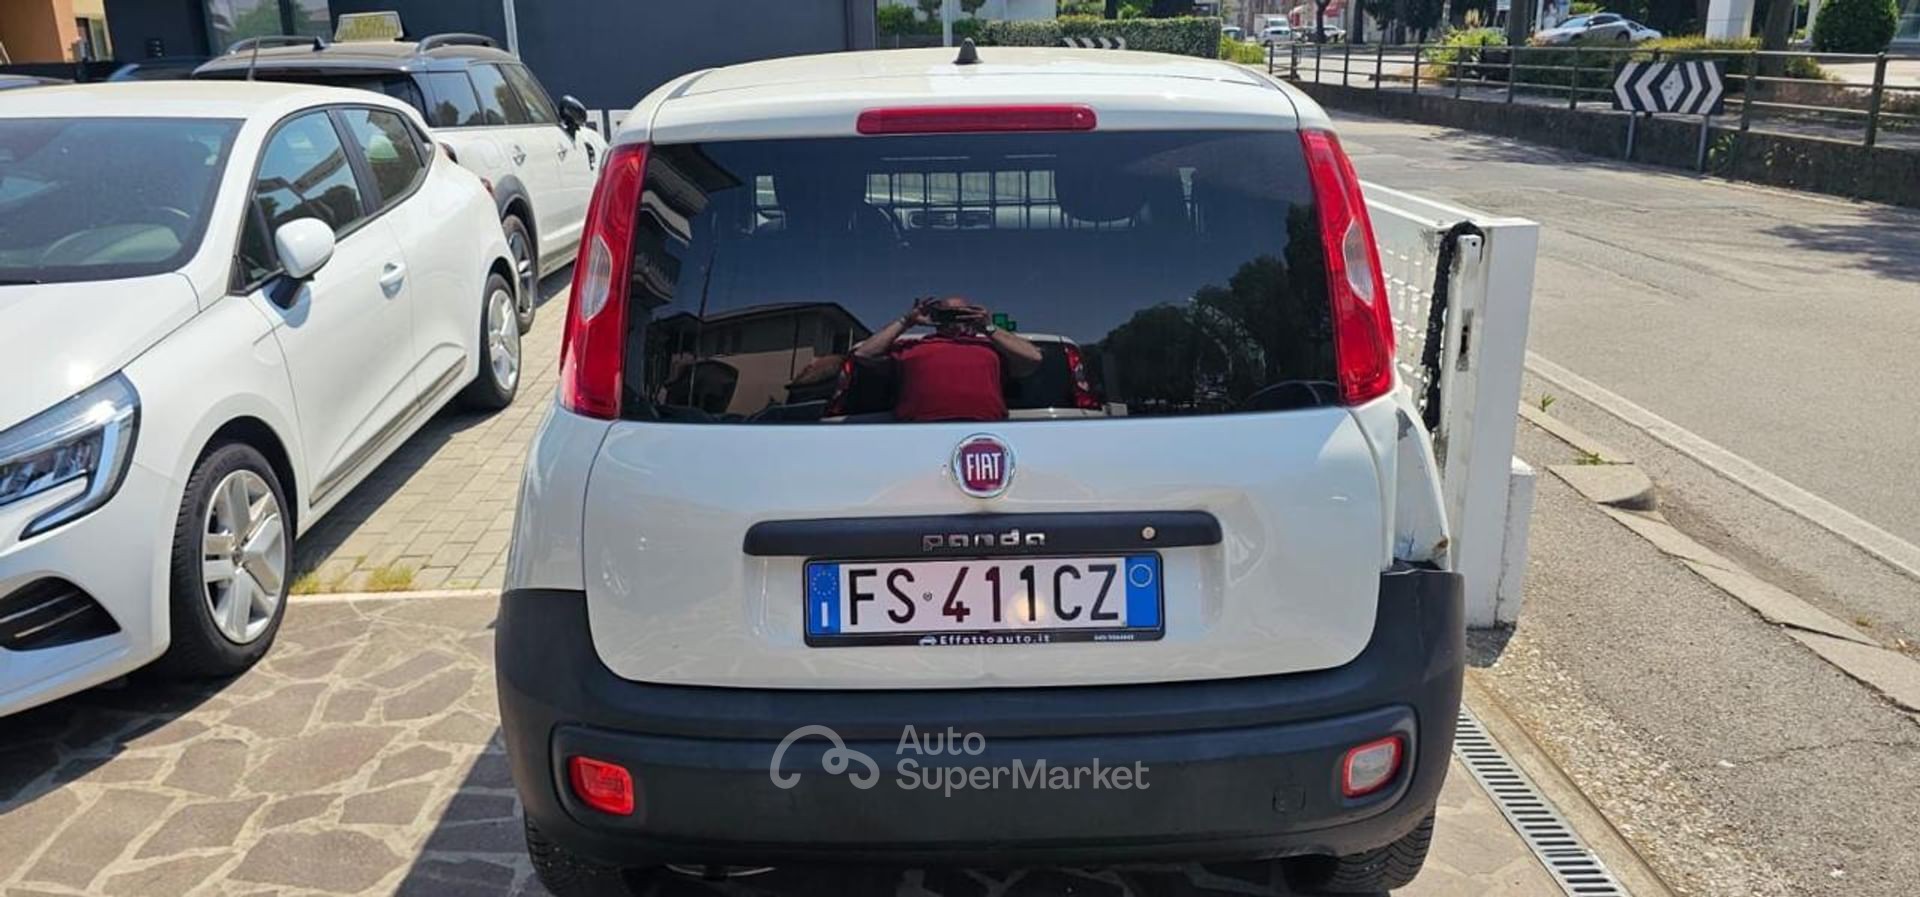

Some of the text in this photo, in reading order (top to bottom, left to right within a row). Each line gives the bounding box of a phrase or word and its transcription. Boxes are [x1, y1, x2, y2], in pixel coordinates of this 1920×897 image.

[966, 452, 1001, 481] FIAT
[922, 529, 1045, 551] panda
[821, 602, 829, 627] I
[939, 634, 1050, 645] Effettoauto.it
